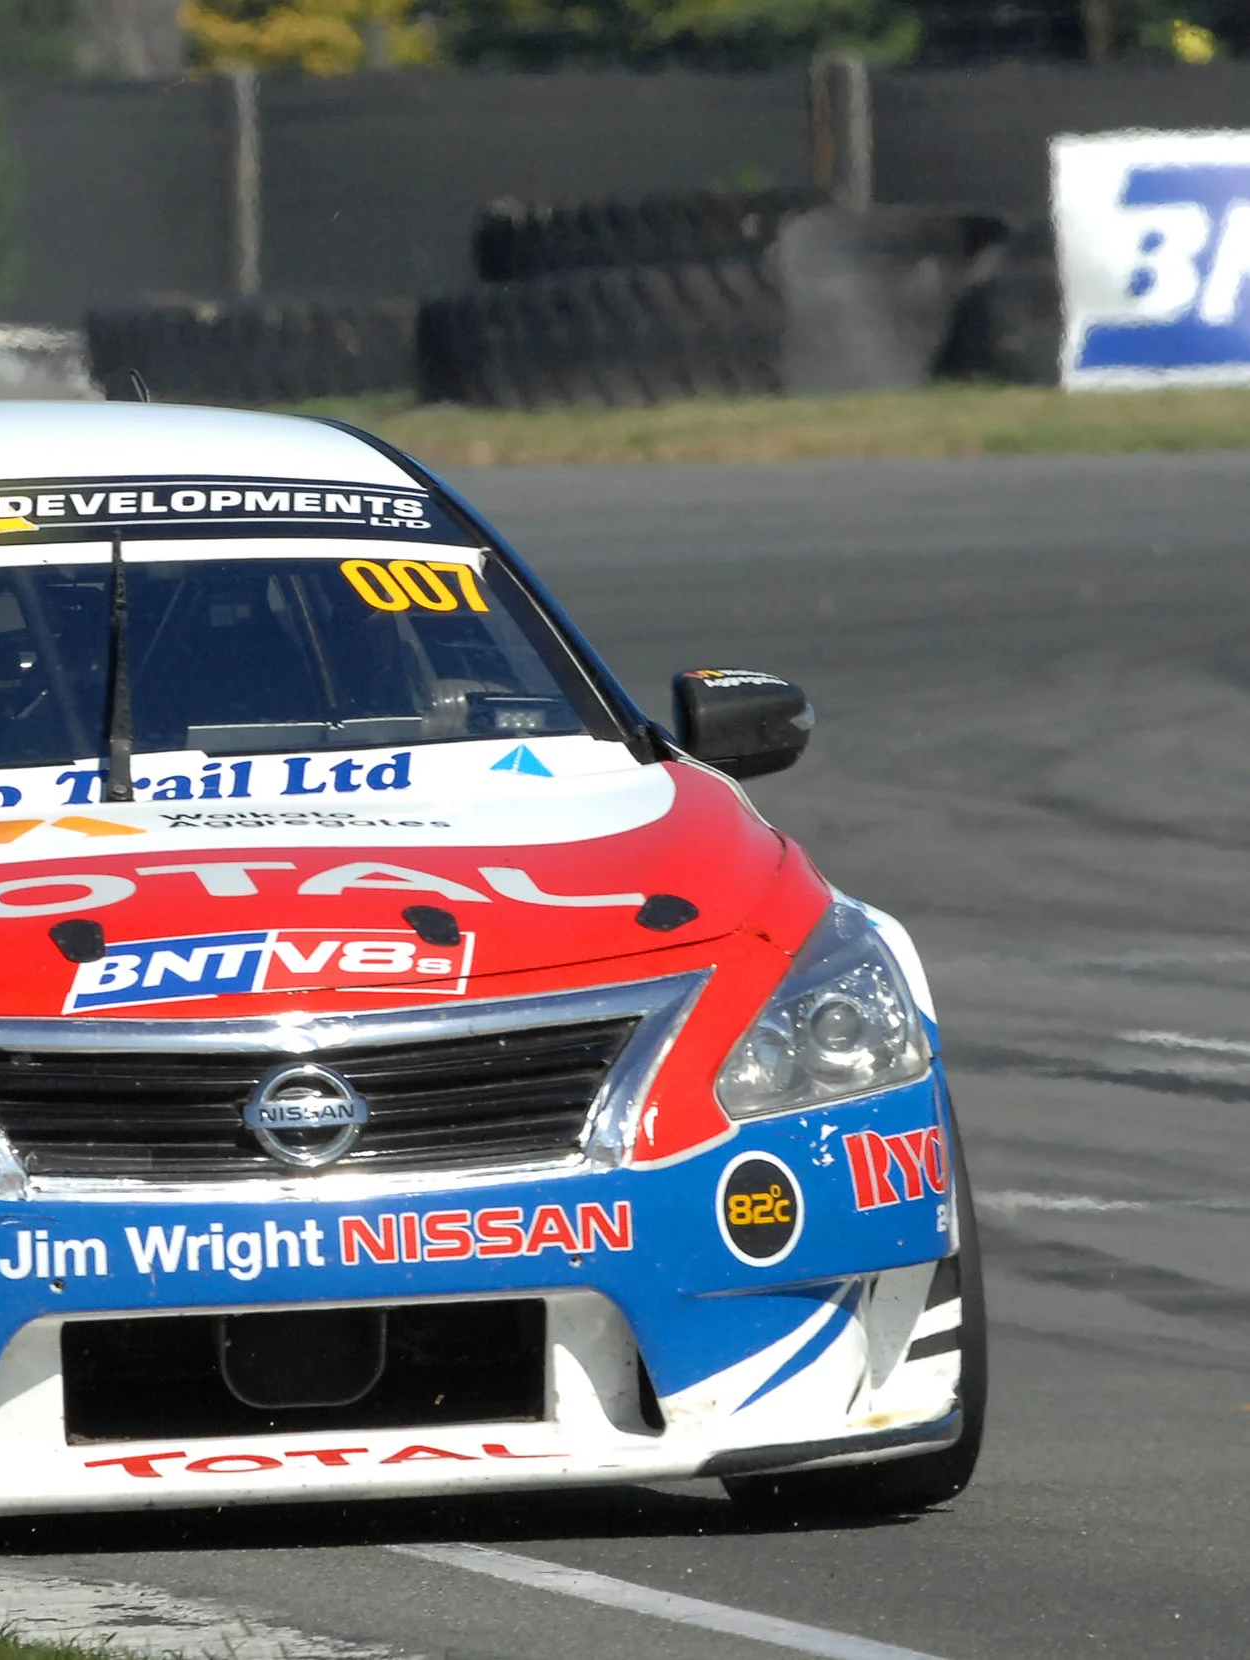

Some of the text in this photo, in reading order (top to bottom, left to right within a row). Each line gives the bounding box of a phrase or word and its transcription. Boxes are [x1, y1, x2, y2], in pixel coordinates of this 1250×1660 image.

[369, 516, 432, 529] LTD
[339, 559, 490, 613] 007
[279, 752, 412, 796] Ltd
[159, 812, 355, 820] Waikato
[168, 819, 452, 829] Aggregates
[76, 942, 267, 995] BNT
[258, 1103, 355, 1123] NISSAN
[124, 1219, 326, 1282] Wright
[338, 1201, 634, 1266] NISSAN
[83, 1443, 572, 1478] TOTAL
